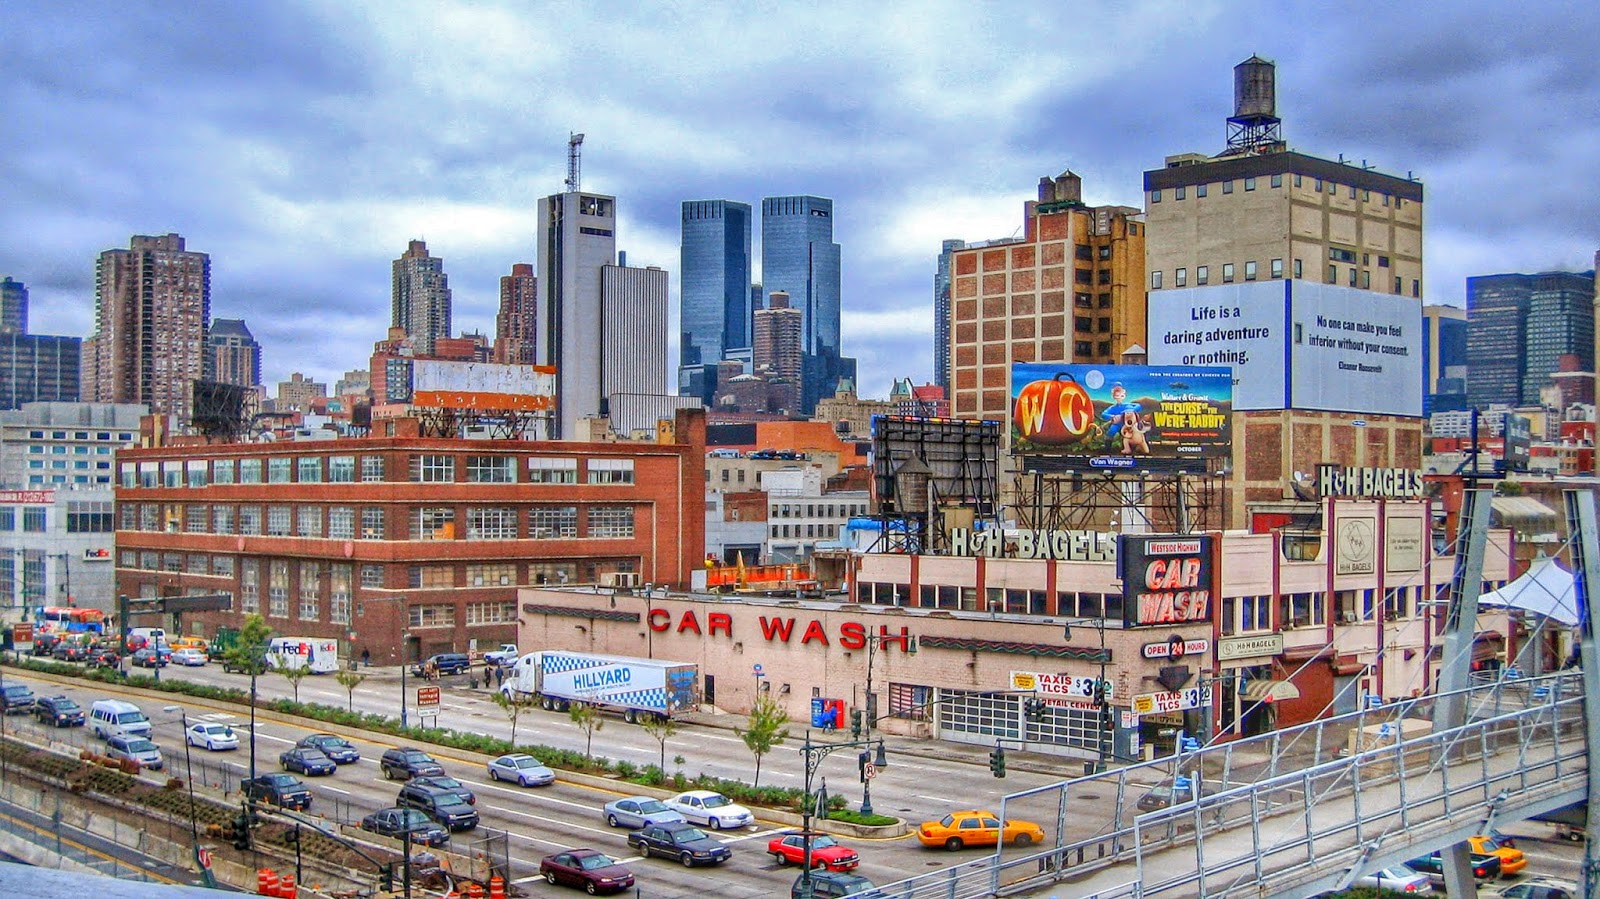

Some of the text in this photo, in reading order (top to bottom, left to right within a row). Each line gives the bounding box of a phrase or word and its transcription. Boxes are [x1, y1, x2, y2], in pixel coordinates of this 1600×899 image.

[1191, 305, 1240, 320] Life is a
[1317, 315, 1402, 337] No one can make you feel
[1163, 327, 1269, 345] daring adventure
[1309, 334, 1409, 356] inferior without your consent.
[1183, 349, 1249, 365] or nothing.
[1338, 361, 1382, 373] Eleanor Roosevelt
[1161, 402, 1174, 411] THE
[1174, 402, 1201, 414] CURSE
[1107, 459, 1134, 467] Wagner
[1320, 466, 1424, 497] H&H BAGELS
[951, 527, 1118, 560] H&H BAGELS
[1151, 543, 1199, 552] WESTSIDE HIGHWAY
[85, 549, 110, 558] FedEx
[1352, 563, 1372, 571] BAGELS
[1145, 558, 1201, 591] CAR
[1137, 591, 1209, 624] WASH
[647, 608, 909, 652] CAR WASH
[1147, 642, 1206, 656] OPEN 24 HOURS
[1251, 640, 1276, 649] BAGELS
[573, 667, 631, 690] HILLYARD
[1038, 674, 1072, 685] TAXIS
[1041, 684, 1069, 694] TLCS
[1155, 690, 1182, 702] TAXIS
[1158, 701, 1180, 711] TLCS
